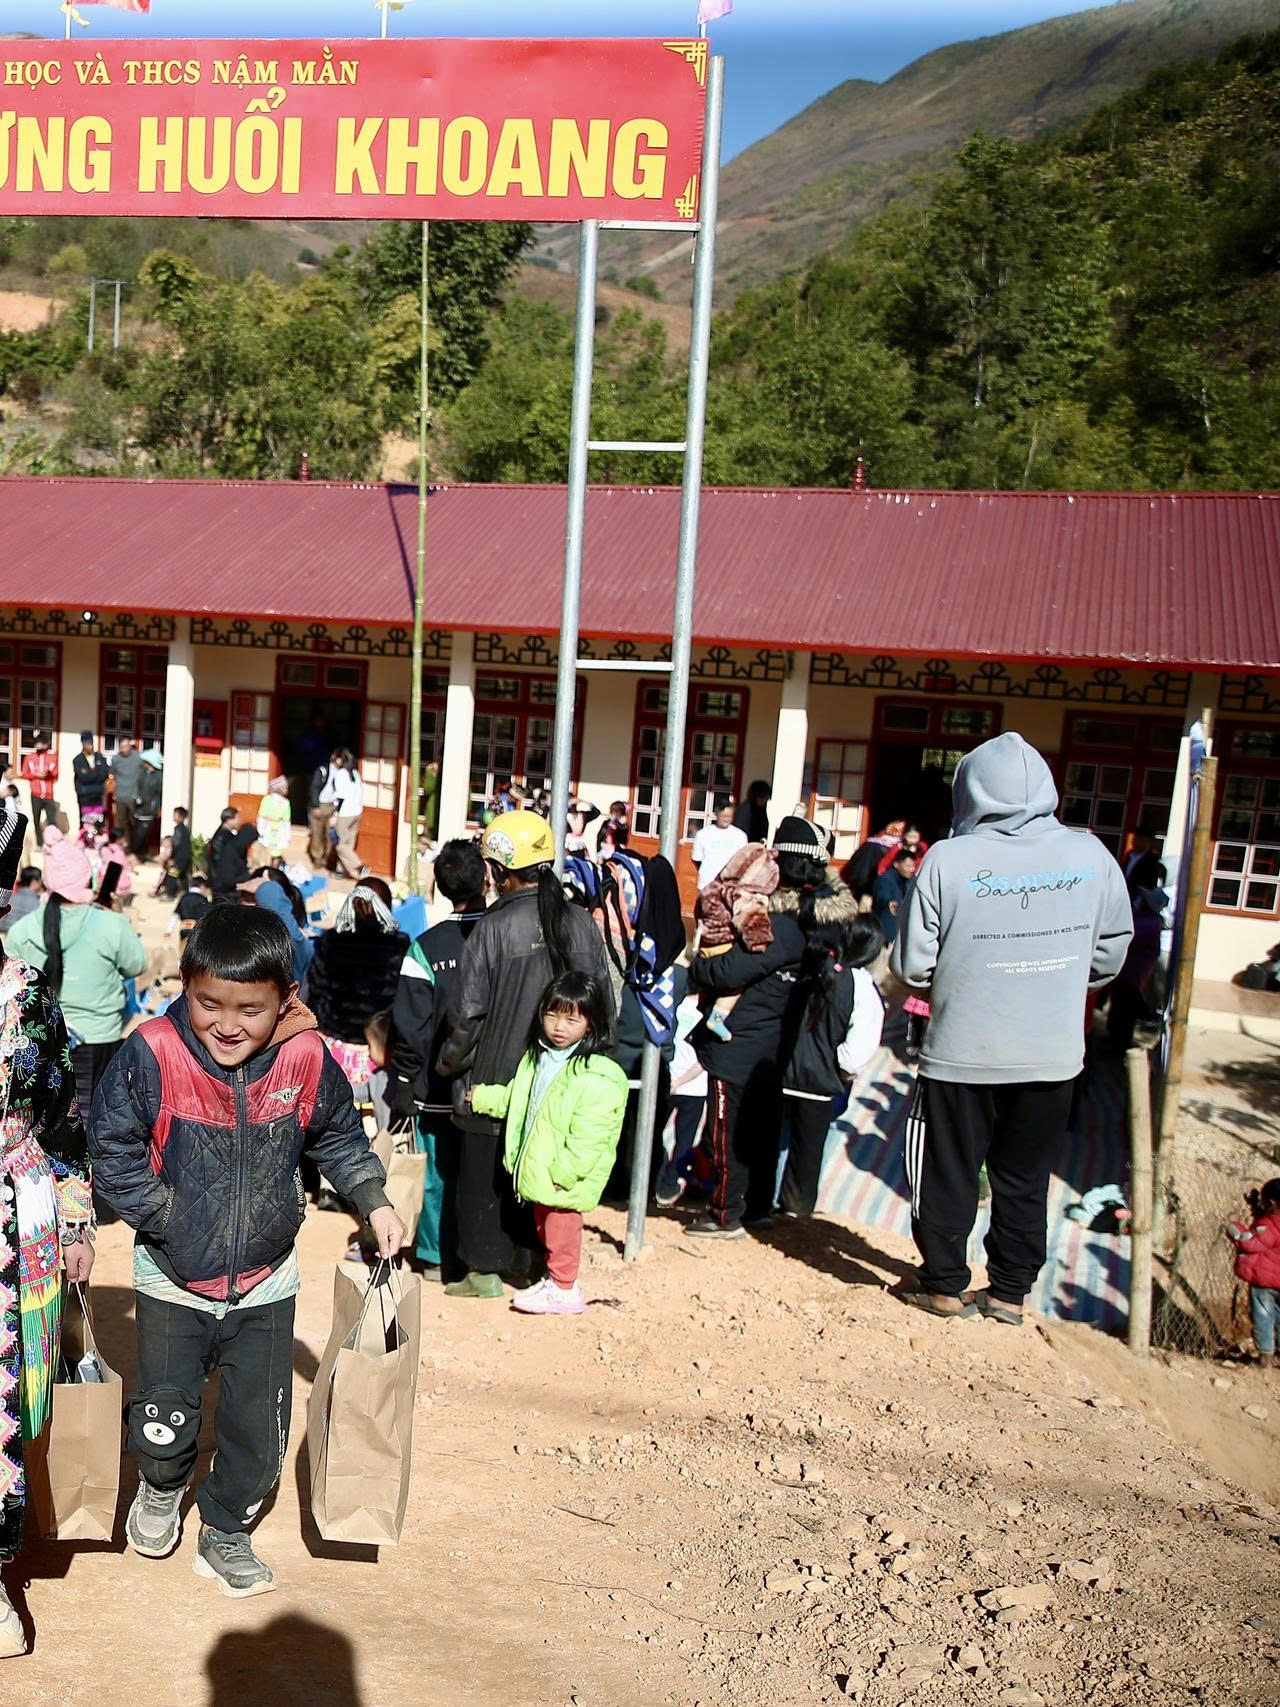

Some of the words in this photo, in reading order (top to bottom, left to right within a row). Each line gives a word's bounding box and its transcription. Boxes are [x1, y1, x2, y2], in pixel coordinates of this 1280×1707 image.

[3, 60, 62, 92] HỌC
[73, 51, 112, 86] VÀ
[122, 59, 202, 86] THCS
[211, 53, 279, 91] NẬM
[137, 85, 304, 195] HUỔI
[334, 116, 670, 200] KHOANG
